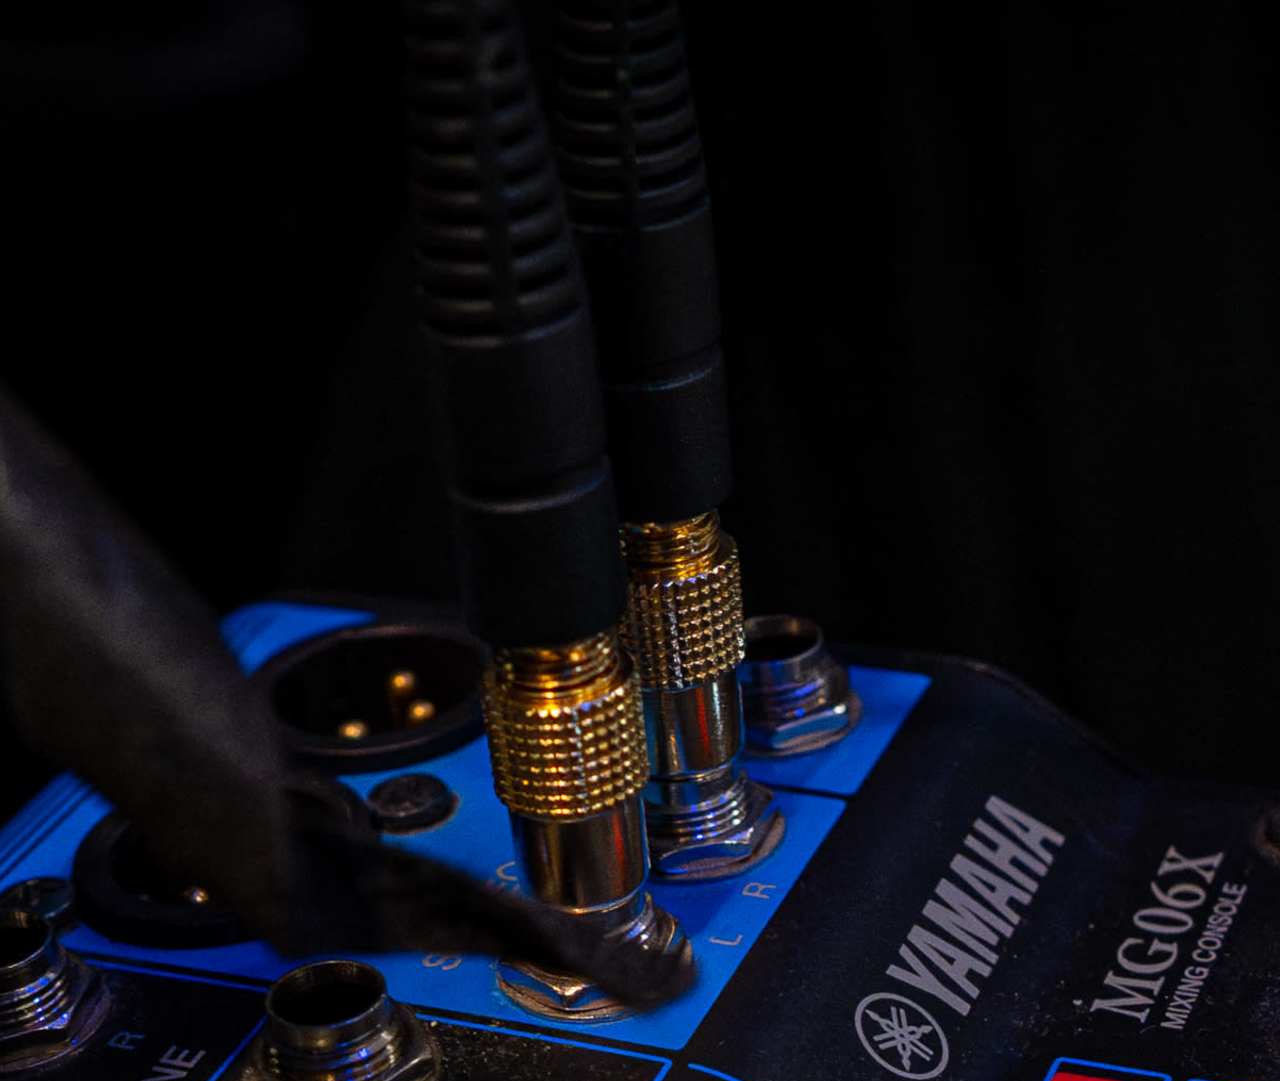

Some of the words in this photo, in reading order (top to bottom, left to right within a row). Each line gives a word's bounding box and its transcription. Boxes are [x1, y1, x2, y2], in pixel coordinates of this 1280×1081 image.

[743, 881, 776, 900] R
[886, 795, 1066, 1017] YAMAHA
[710, 931, 743, 948] L
[1090, 845, 1224, 1025] MG06X
[1160, 962, 1212, 1031] MIXING
[1191, 881, 1248, 966] CONSOLE
[106, 1030, 145, 1053] R
